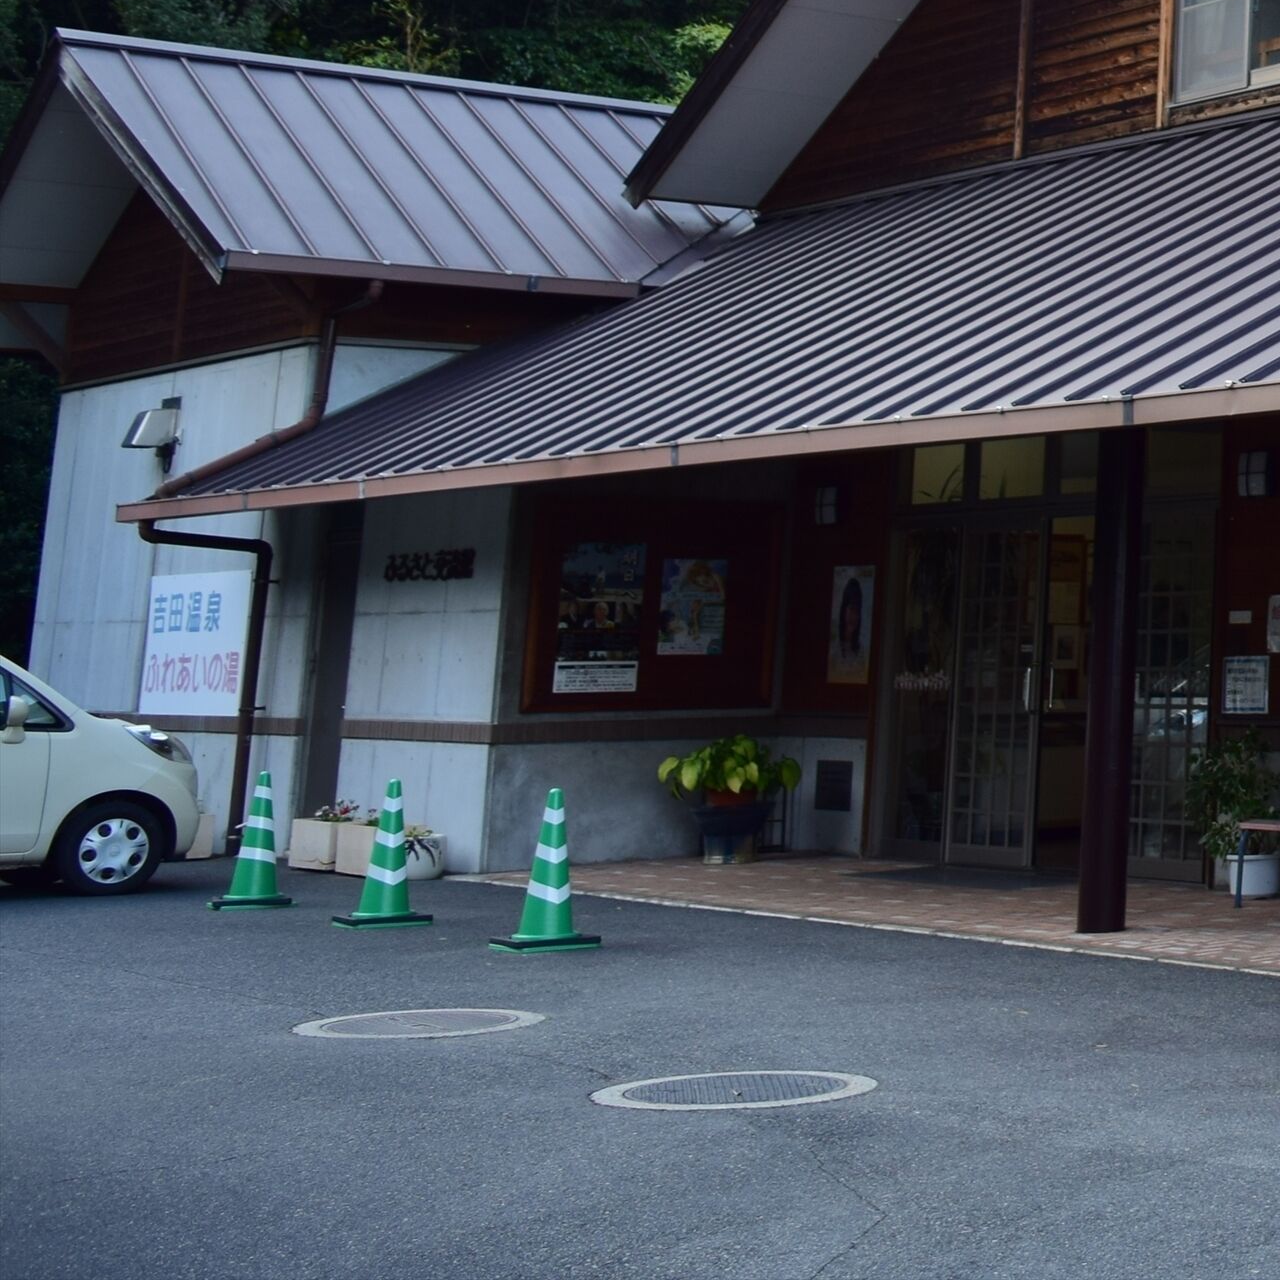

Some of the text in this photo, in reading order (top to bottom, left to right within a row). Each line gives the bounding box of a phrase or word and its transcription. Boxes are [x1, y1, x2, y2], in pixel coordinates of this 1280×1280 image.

[153, 591, 222, 634] 吉田温泉
[144, 651, 240, 694] ふれあいの湯
